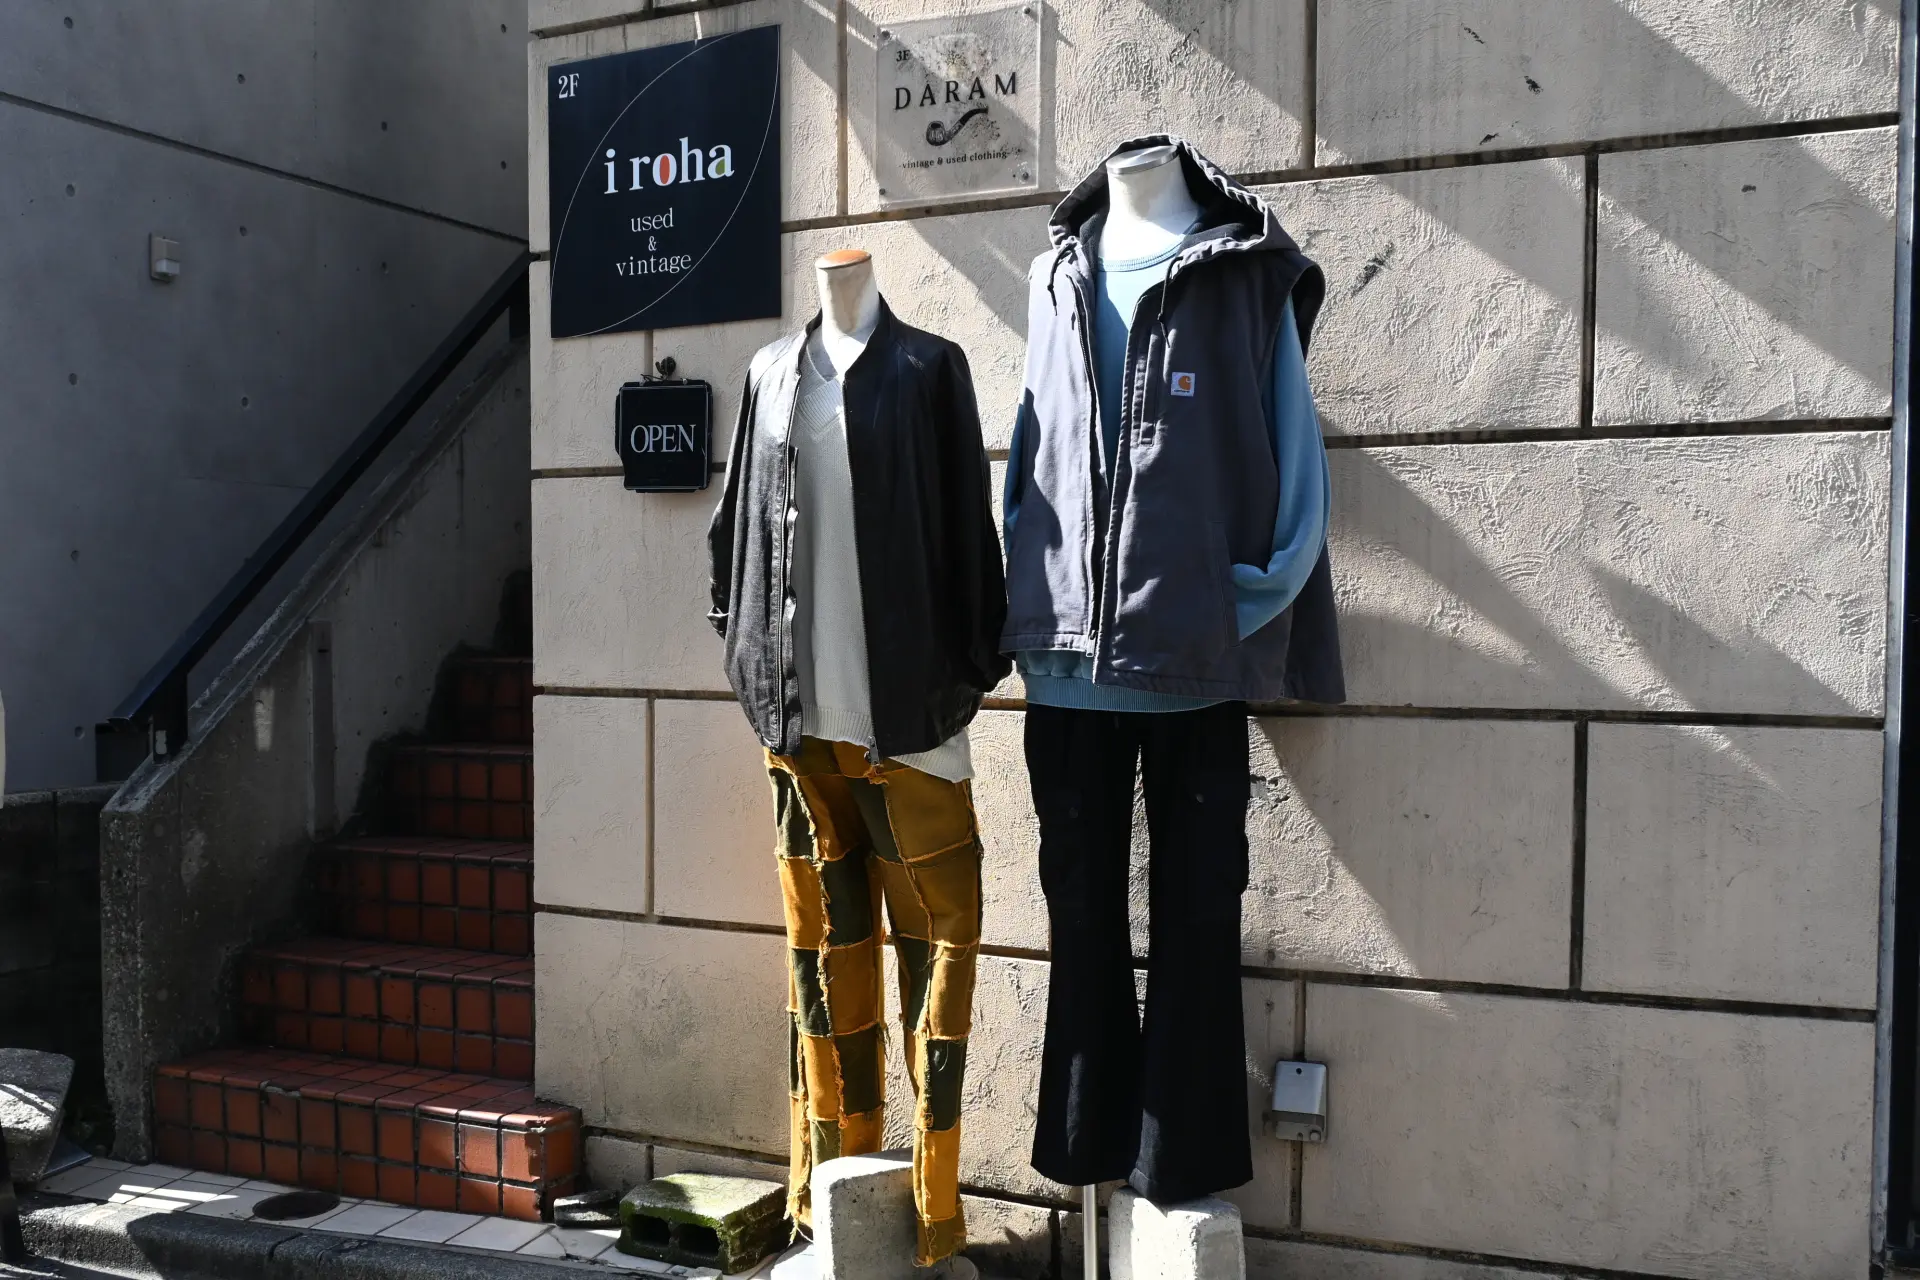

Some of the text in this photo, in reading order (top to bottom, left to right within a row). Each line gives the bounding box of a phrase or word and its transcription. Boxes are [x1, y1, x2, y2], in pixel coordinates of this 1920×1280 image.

[558, 73, 579, 98] 2F
[895, 72, 1016, 110] DARAM
[604, 136, 734, 194] iroha
[937, 157, 943, 166] &
[946, 154, 967, 165] used
[631, 207, 674, 232] used
[648, 236, 657, 251] &
[616, 254, 691, 276] vintage
[630, 424, 696, 453] OPEN
